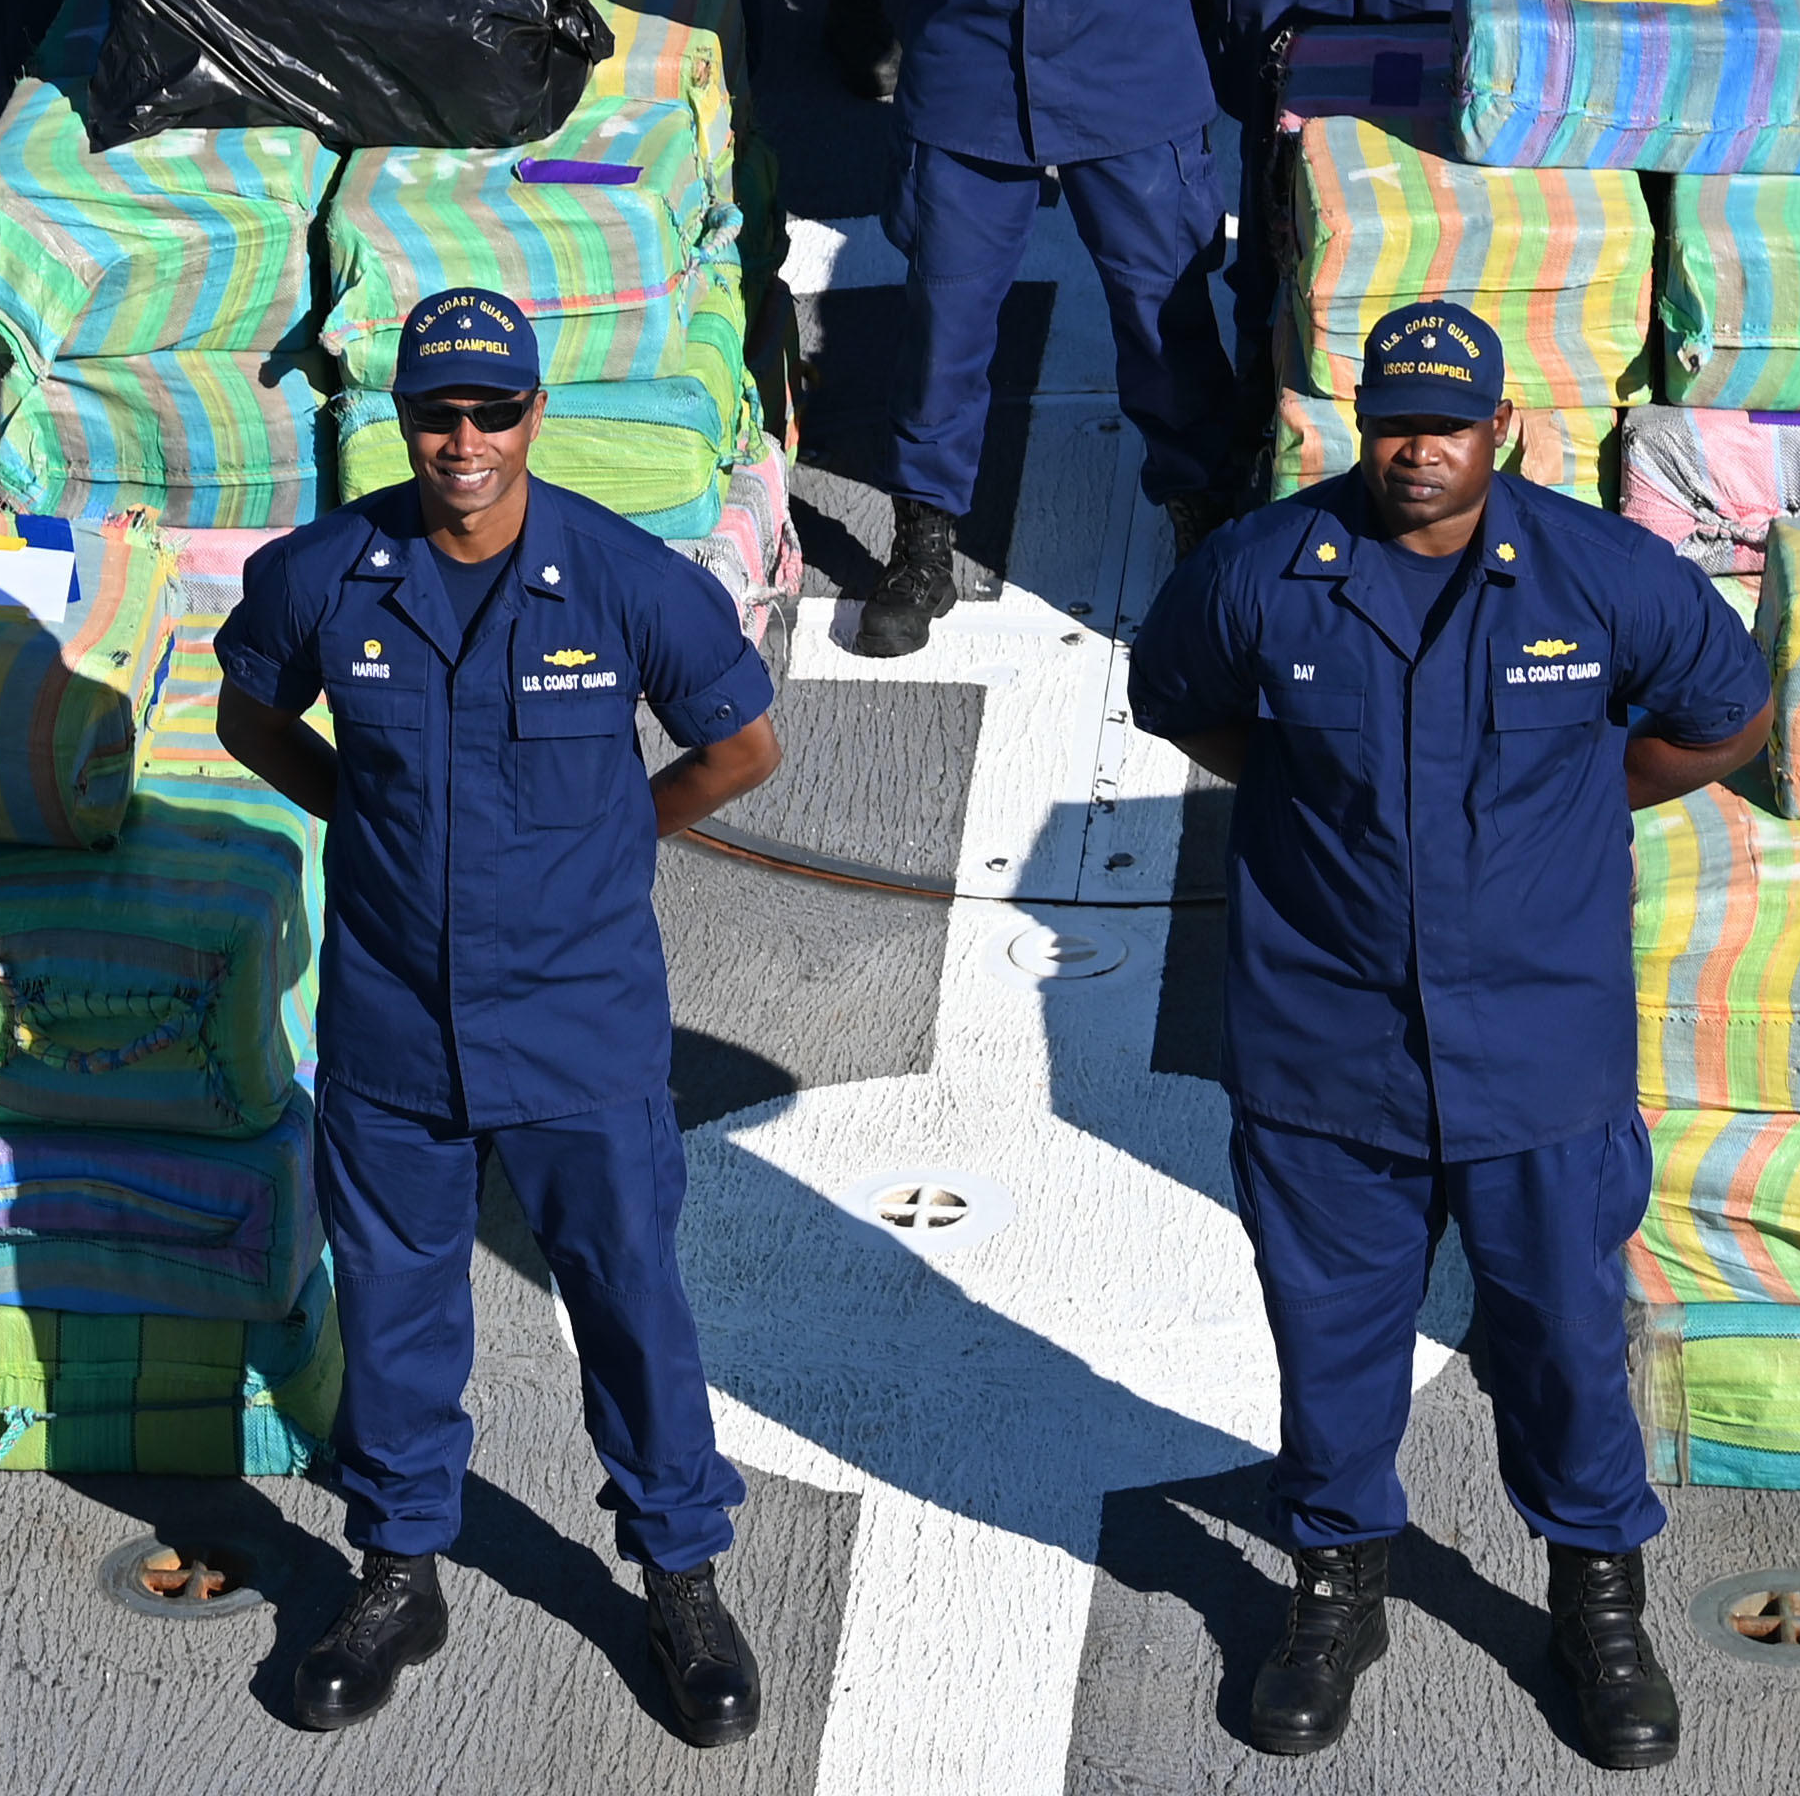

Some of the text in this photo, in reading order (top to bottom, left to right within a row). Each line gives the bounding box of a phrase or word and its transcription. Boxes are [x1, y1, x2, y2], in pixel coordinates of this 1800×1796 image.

[415, 295, 516, 334] U.S. COAST GUARD
[419, 338, 510, 357] USCGC CAMPBELL
[1380, 315, 1481, 359] U.S. COAST GUARD
[1383, 361, 1473, 383] USCGC CAMPBELL
[352, 661, 391, 679] HARRIS
[1293, 663, 1315, 681] DAY
[1506, 661, 1601, 684] U.S. COAST GUARD
[522, 671, 617, 692] U.S. COAST GUARD
